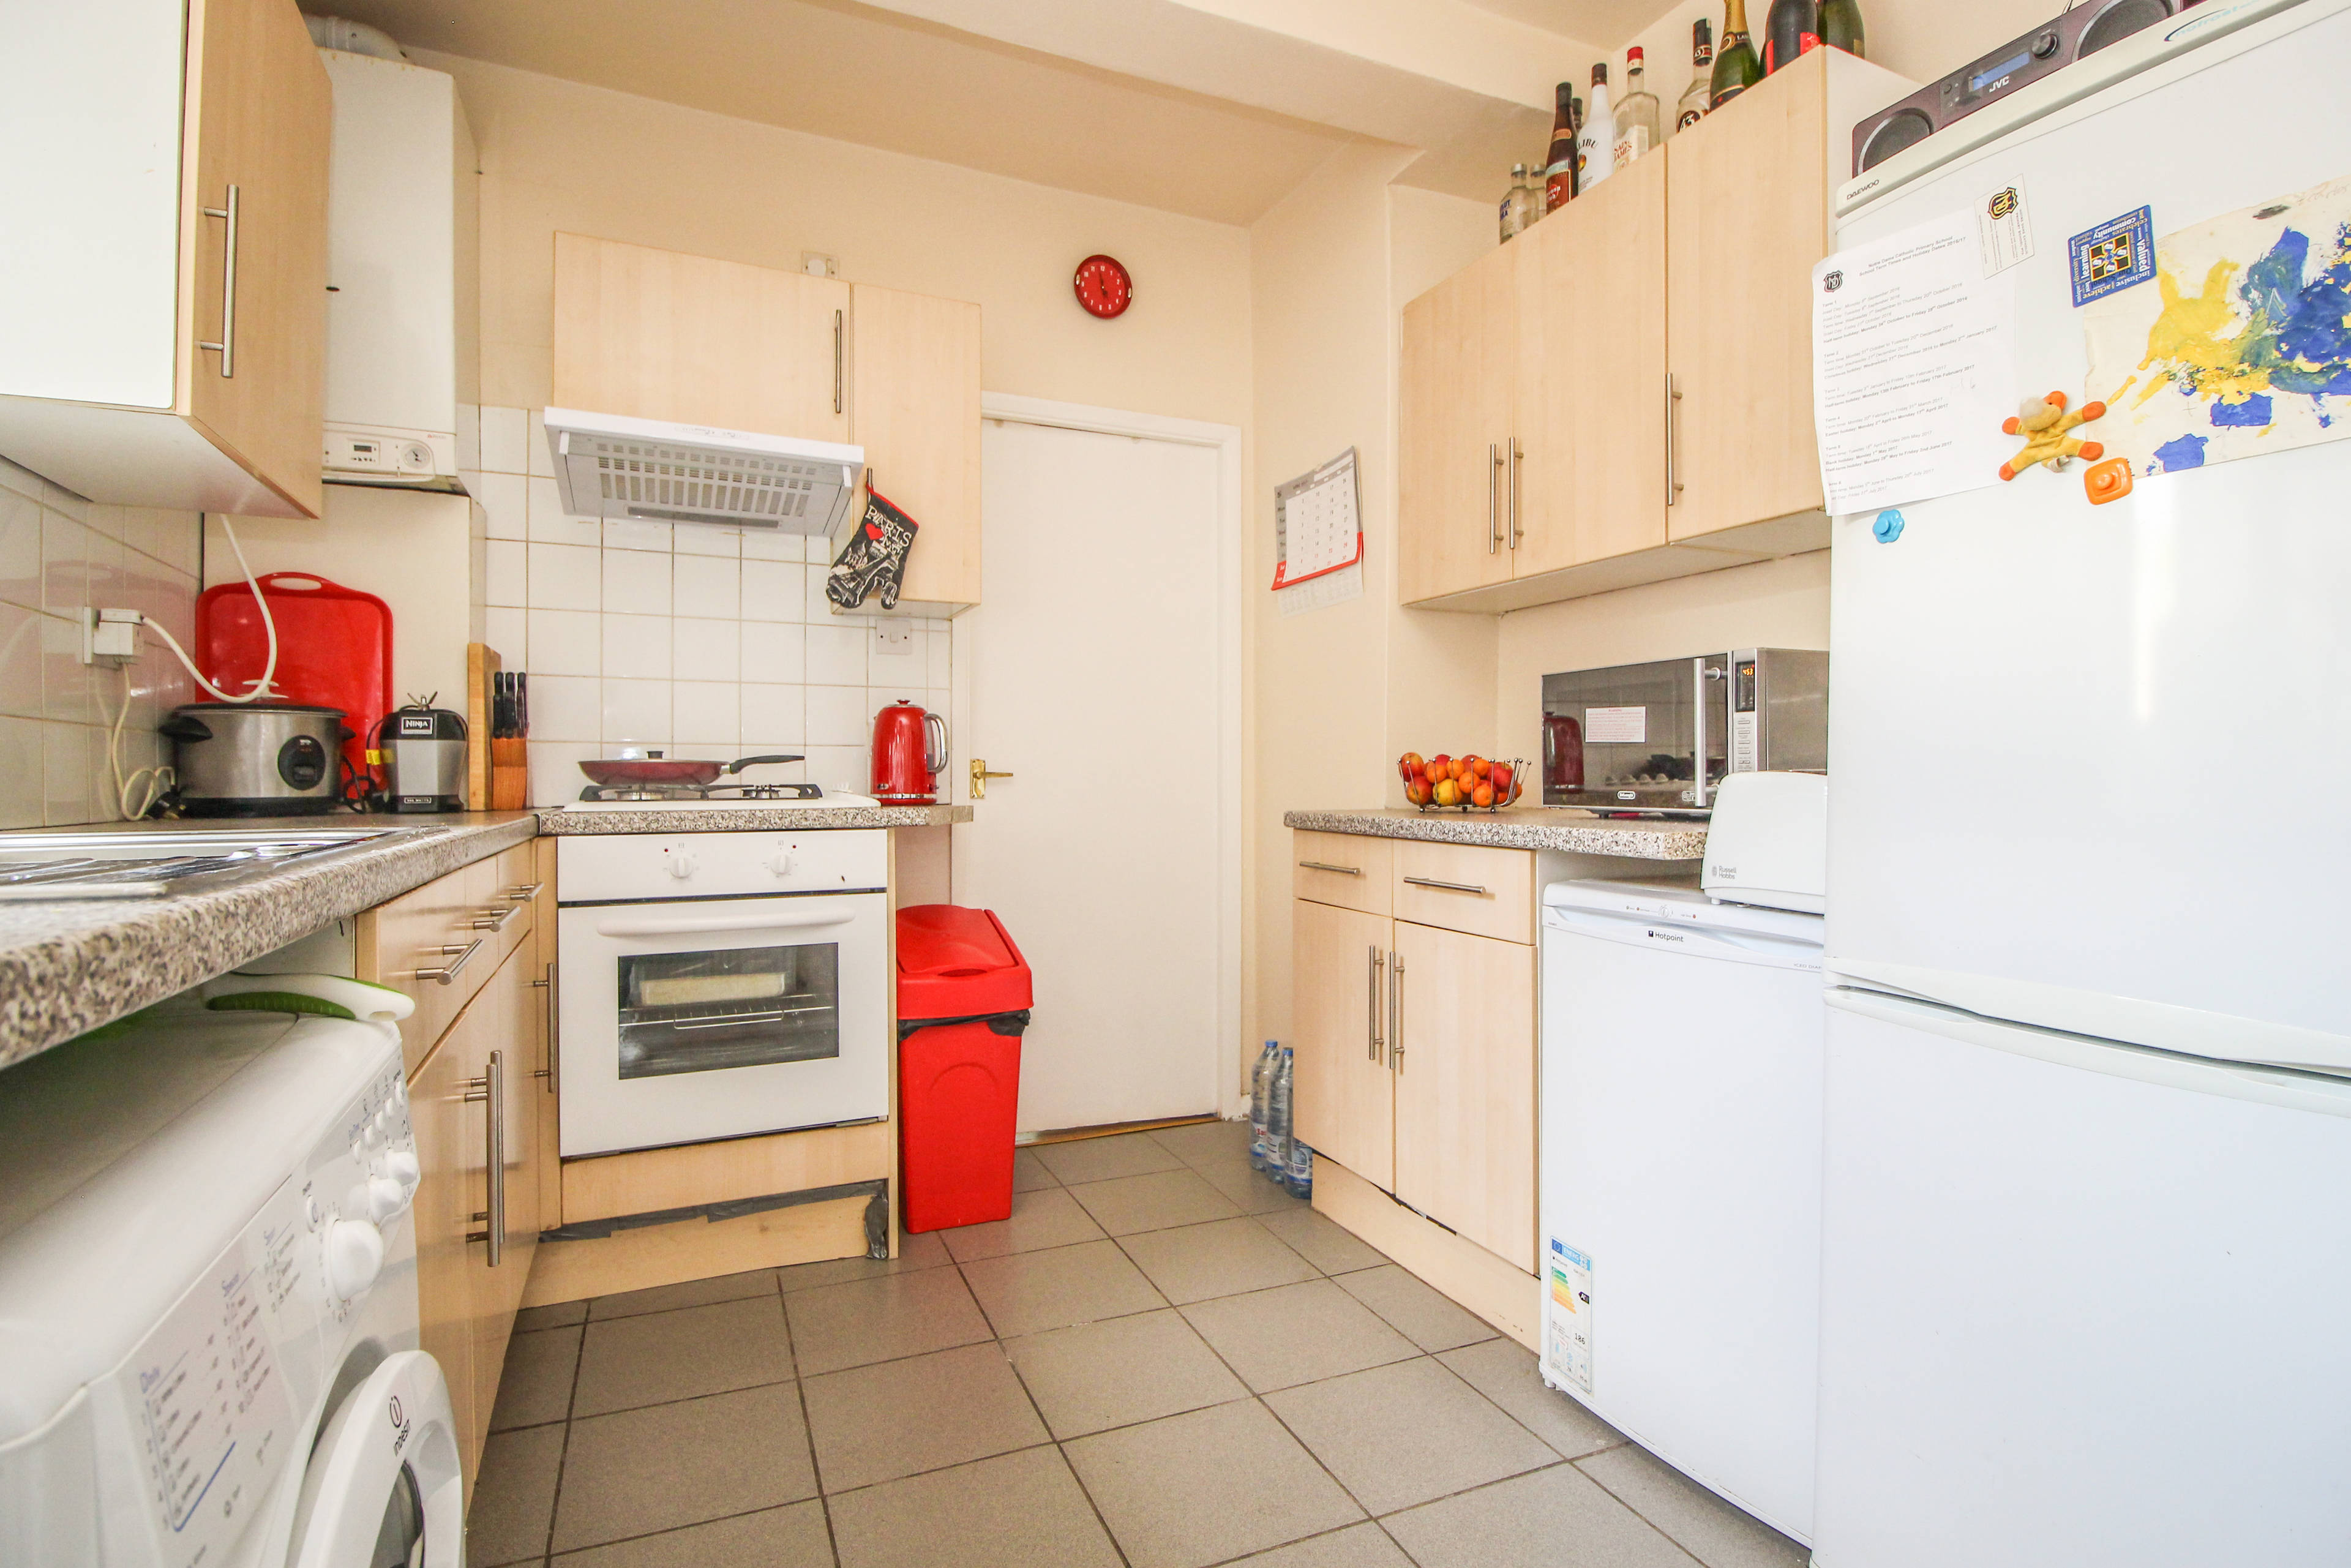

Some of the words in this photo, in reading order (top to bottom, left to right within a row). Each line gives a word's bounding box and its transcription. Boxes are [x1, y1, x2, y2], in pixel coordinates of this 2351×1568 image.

[1989, 76, 2009, 92] JVC
[1578, 138, 1599, 149] LIBU
[1847, 179, 1880, 200] DAEWOO
[2093, 216, 2136, 240] community
[2112, 217, 2147, 237] celebrates
[2078, 243, 2091, 279] learning
[2136, 237, 2150, 272] valued
[2115, 269, 2150, 288] inclusive
[2082, 283, 2111, 300] achieve
[865, 505, 912, 547] PARIS
[405, 719, 429, 729] NINJA
[1655, 932, 1684, 942] Hotpoint
[1575, 1332, 1586, 1345] 186
